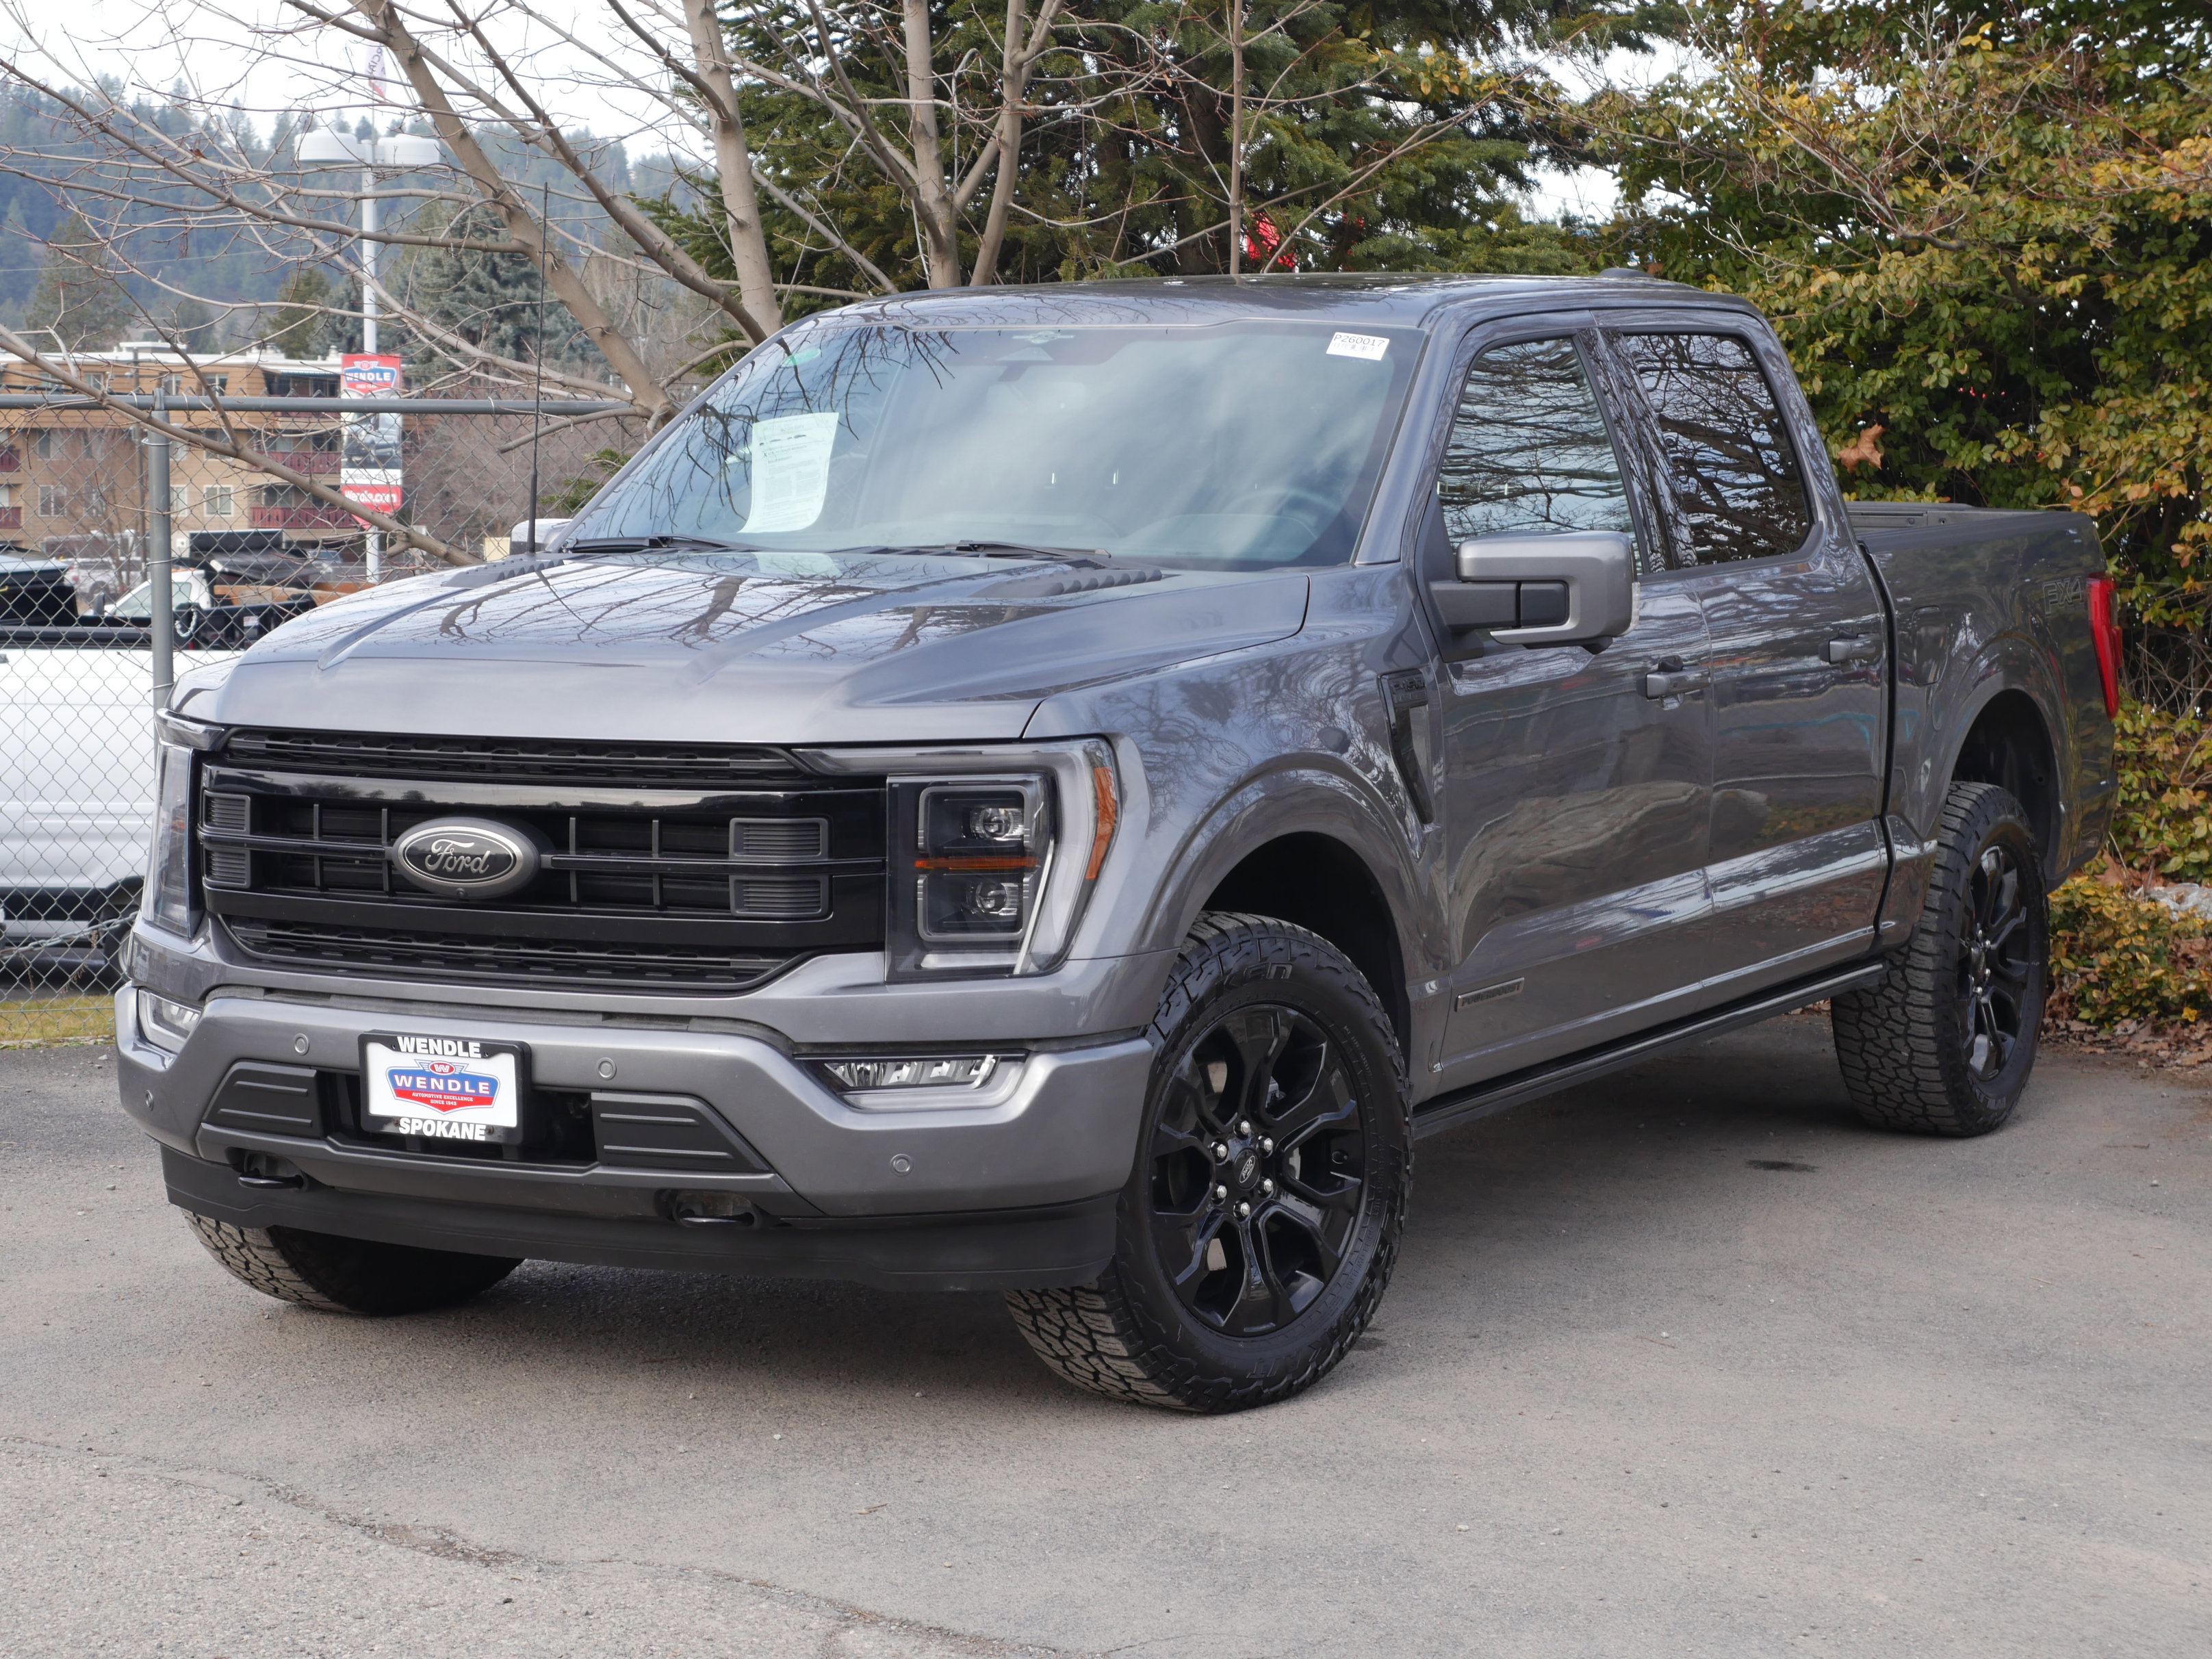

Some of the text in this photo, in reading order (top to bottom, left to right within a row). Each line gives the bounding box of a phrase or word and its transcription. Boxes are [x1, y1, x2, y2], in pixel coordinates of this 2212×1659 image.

[1333, 334, 1385, 347] P260017
[345, 372, 391, 381] WENDLE
[424, 838, 491, 874] Ford
[397, 1036, 482, 1058] WENDLE
[434, 1064, 450, 1072] W
[394, 1075, 489, 1094] WENDLE
[398, 1117, 486, 1141] SPOKANE
